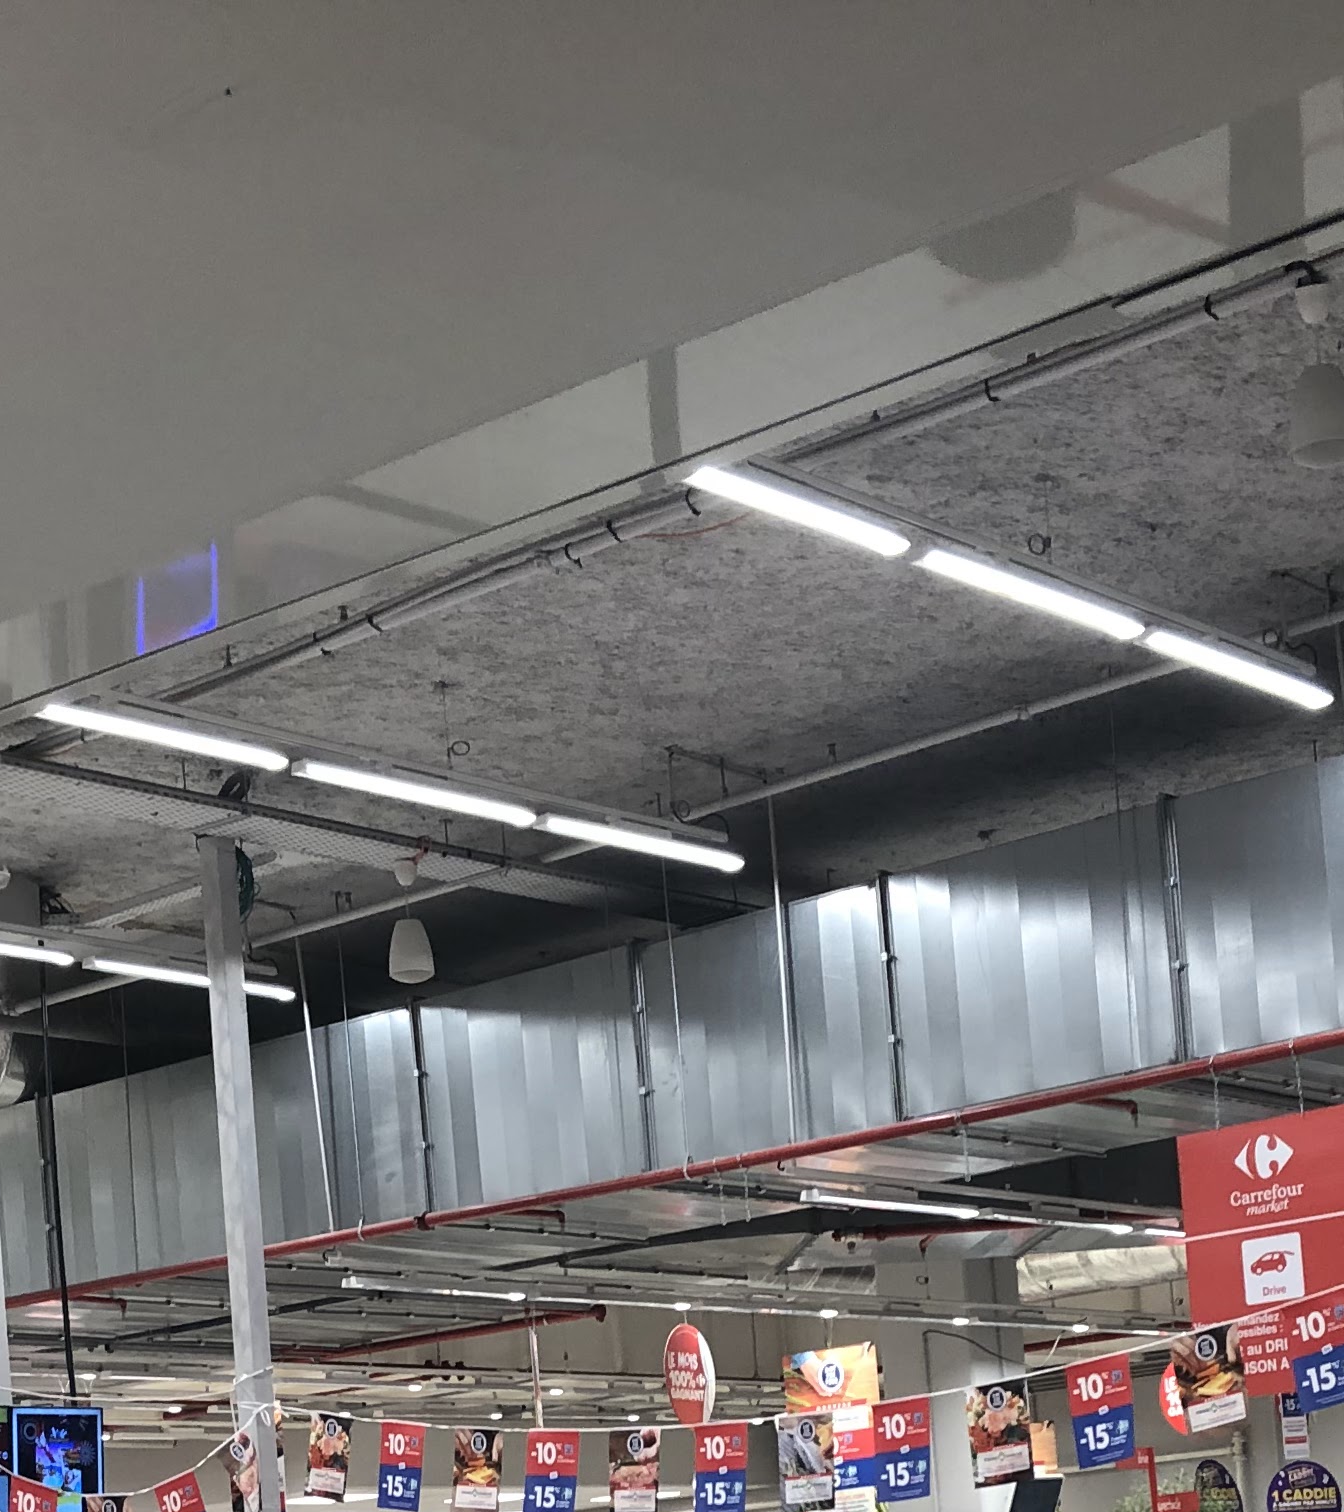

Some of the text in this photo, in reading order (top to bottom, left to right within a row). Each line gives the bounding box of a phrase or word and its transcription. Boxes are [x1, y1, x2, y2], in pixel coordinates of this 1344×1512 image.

[1230, 1183, 1304, 1207] Carrefour
[1246, 1199, 1289, 1216] market
[1262, 1285, 1287, 1297] Drive
[1247, 1345, 1262, 1356] au
[667, 1351, 698, 1370] LE MOIS
[669, 1370, 696, 1389] 100%
[1271, 1487, 1336, 1502] 1 CADDIE
